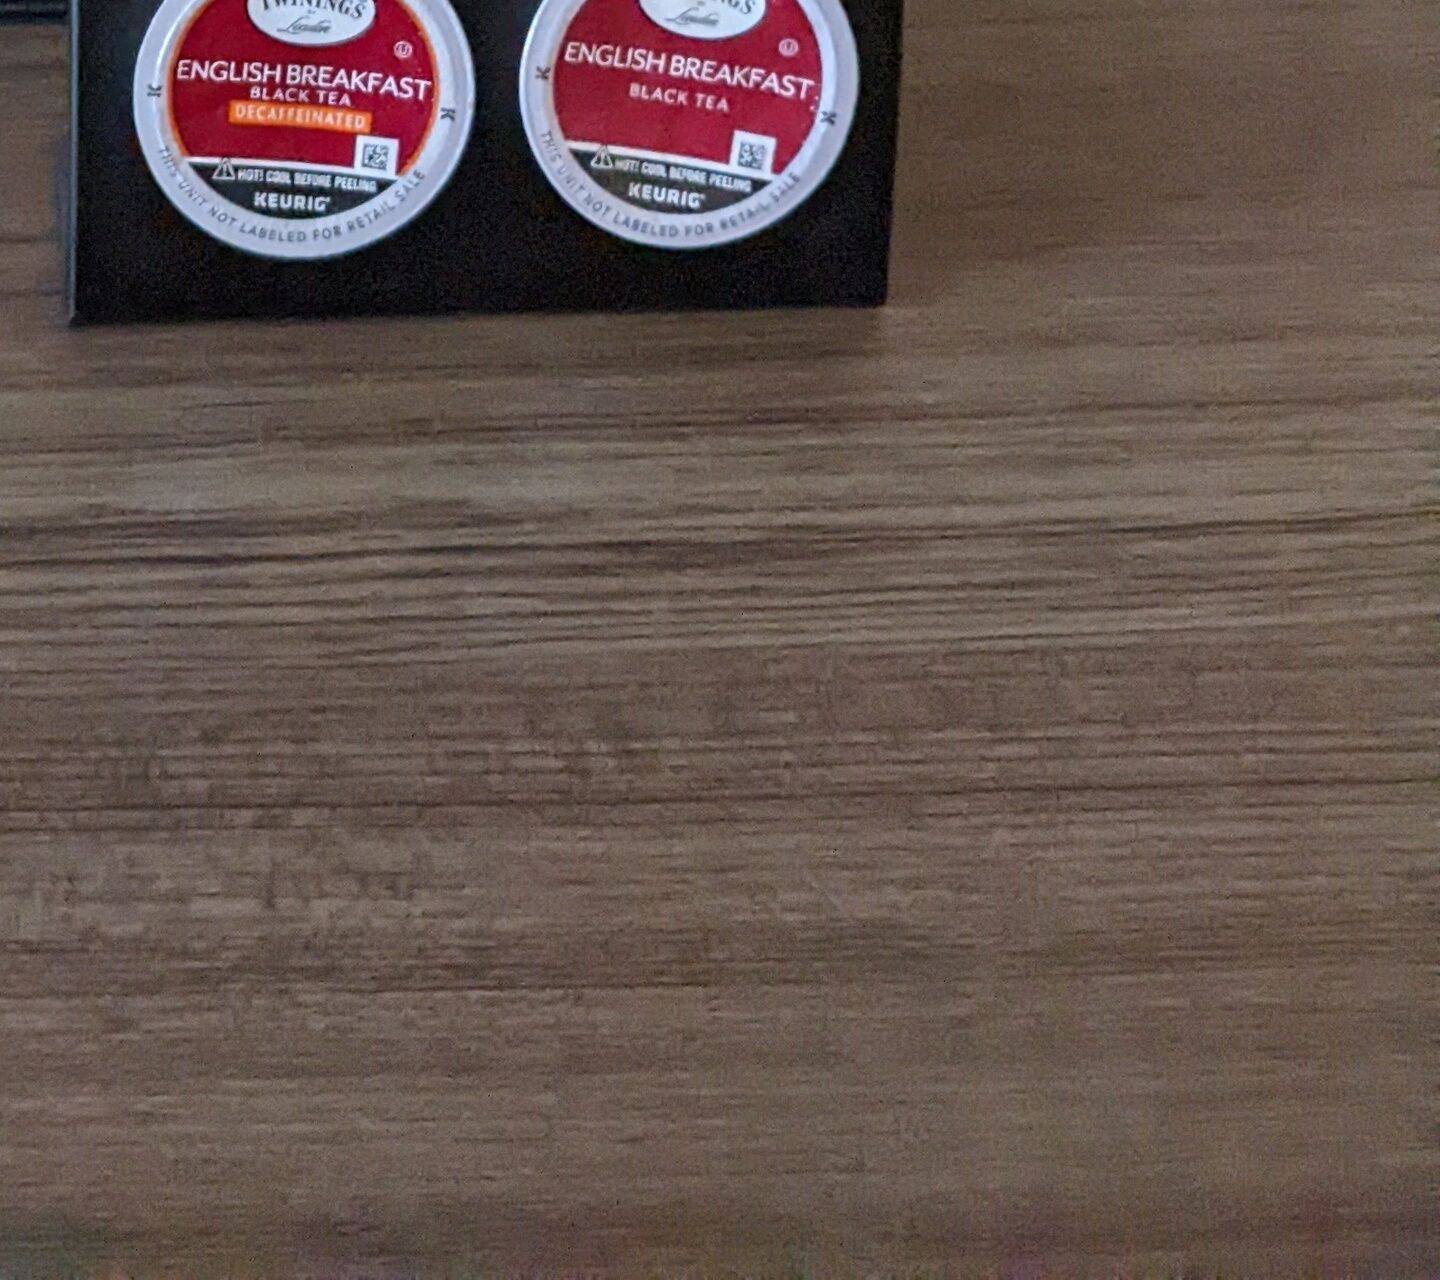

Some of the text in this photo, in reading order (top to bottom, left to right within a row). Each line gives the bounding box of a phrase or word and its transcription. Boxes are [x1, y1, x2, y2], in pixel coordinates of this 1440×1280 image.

[177, 59, 432, 101] ENGLISH BREAKFAST
[564, 41, 814, 101] ENGLISH BREAKFAST
[250, 87, 351, 107] BLACK TEA
[629, 83, 730, 113] BLACK TEA
[235, 104, 366, 129] DECAFFEINATED
[294, 172, 331, 188] BEFORE
[334, 176, 378, 191] PEELING
[669, 166, 707, 184] BEFORE
[709, 173, 752, 192] PEELING
[159, 145, 426, 242] THIS UNIT NOT LABELED FOR RETAIL SALE
[254, 192, 327, 211] KEURIG
[628, 182, 701, 209] KEURIG
[584, 193, 611, 217] NOT
[613, 210, 679, 237] LABELED
[684, 222, 714, 238] FOR
[719, 200, 772, 230] RETAIL
